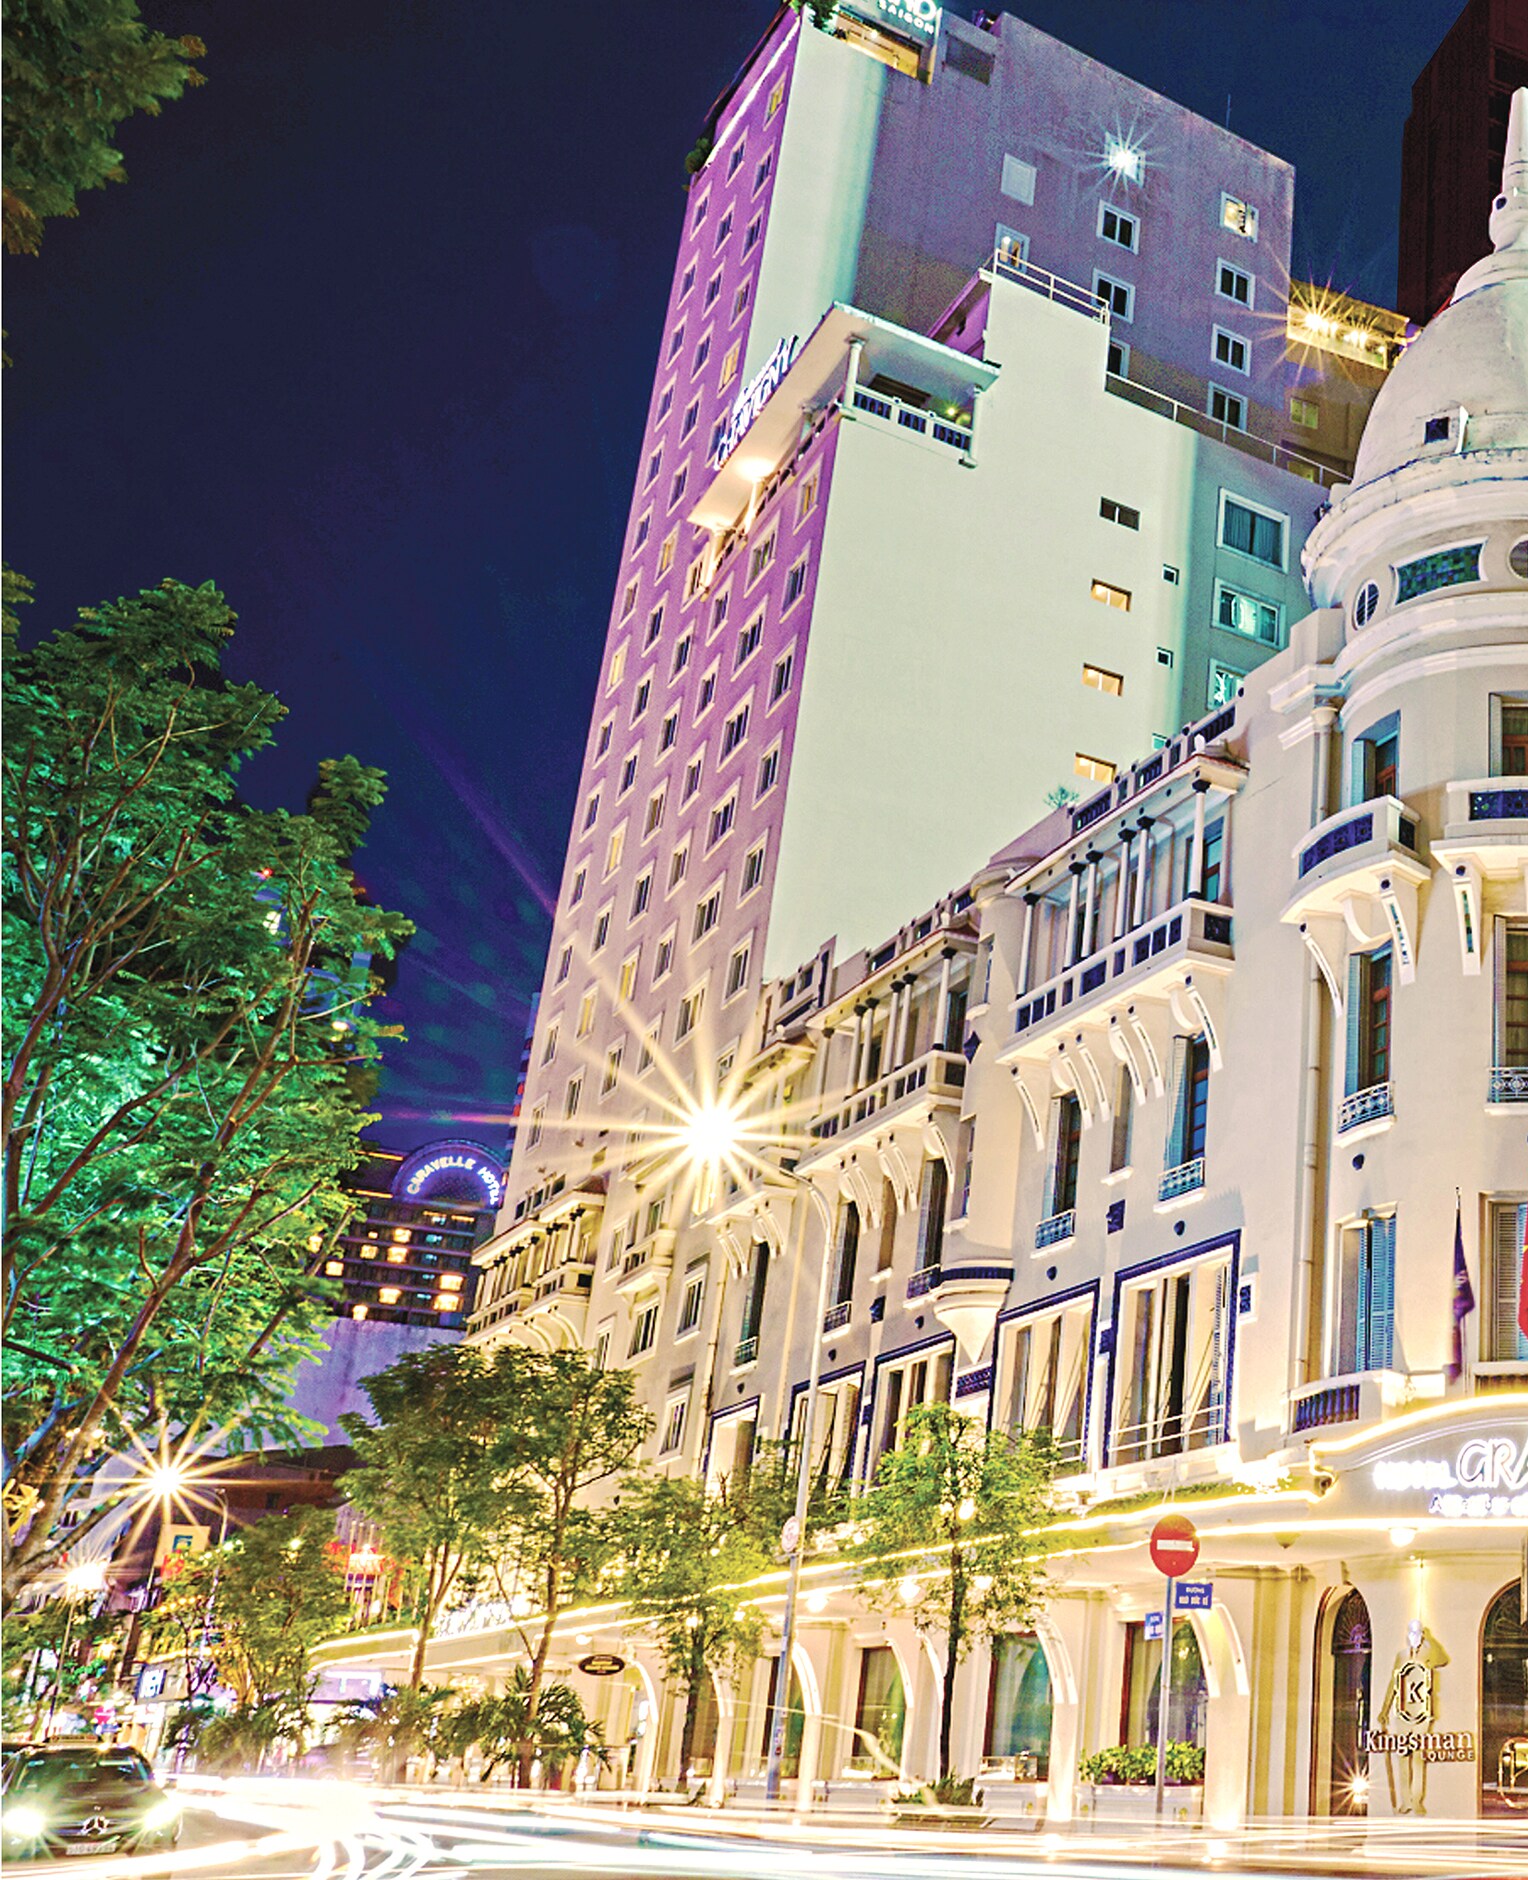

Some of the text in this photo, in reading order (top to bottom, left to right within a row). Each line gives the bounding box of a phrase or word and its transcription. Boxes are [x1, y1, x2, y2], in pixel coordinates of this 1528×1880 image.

[407, 1156, 500, 1205] CARAVELLE HOTEL
[1404, 1680, 1425, 1705] K
[1365, 1730, 1472, 1754] Kingsman
[1421, 1749, 1475, 1763] LOUNGE
